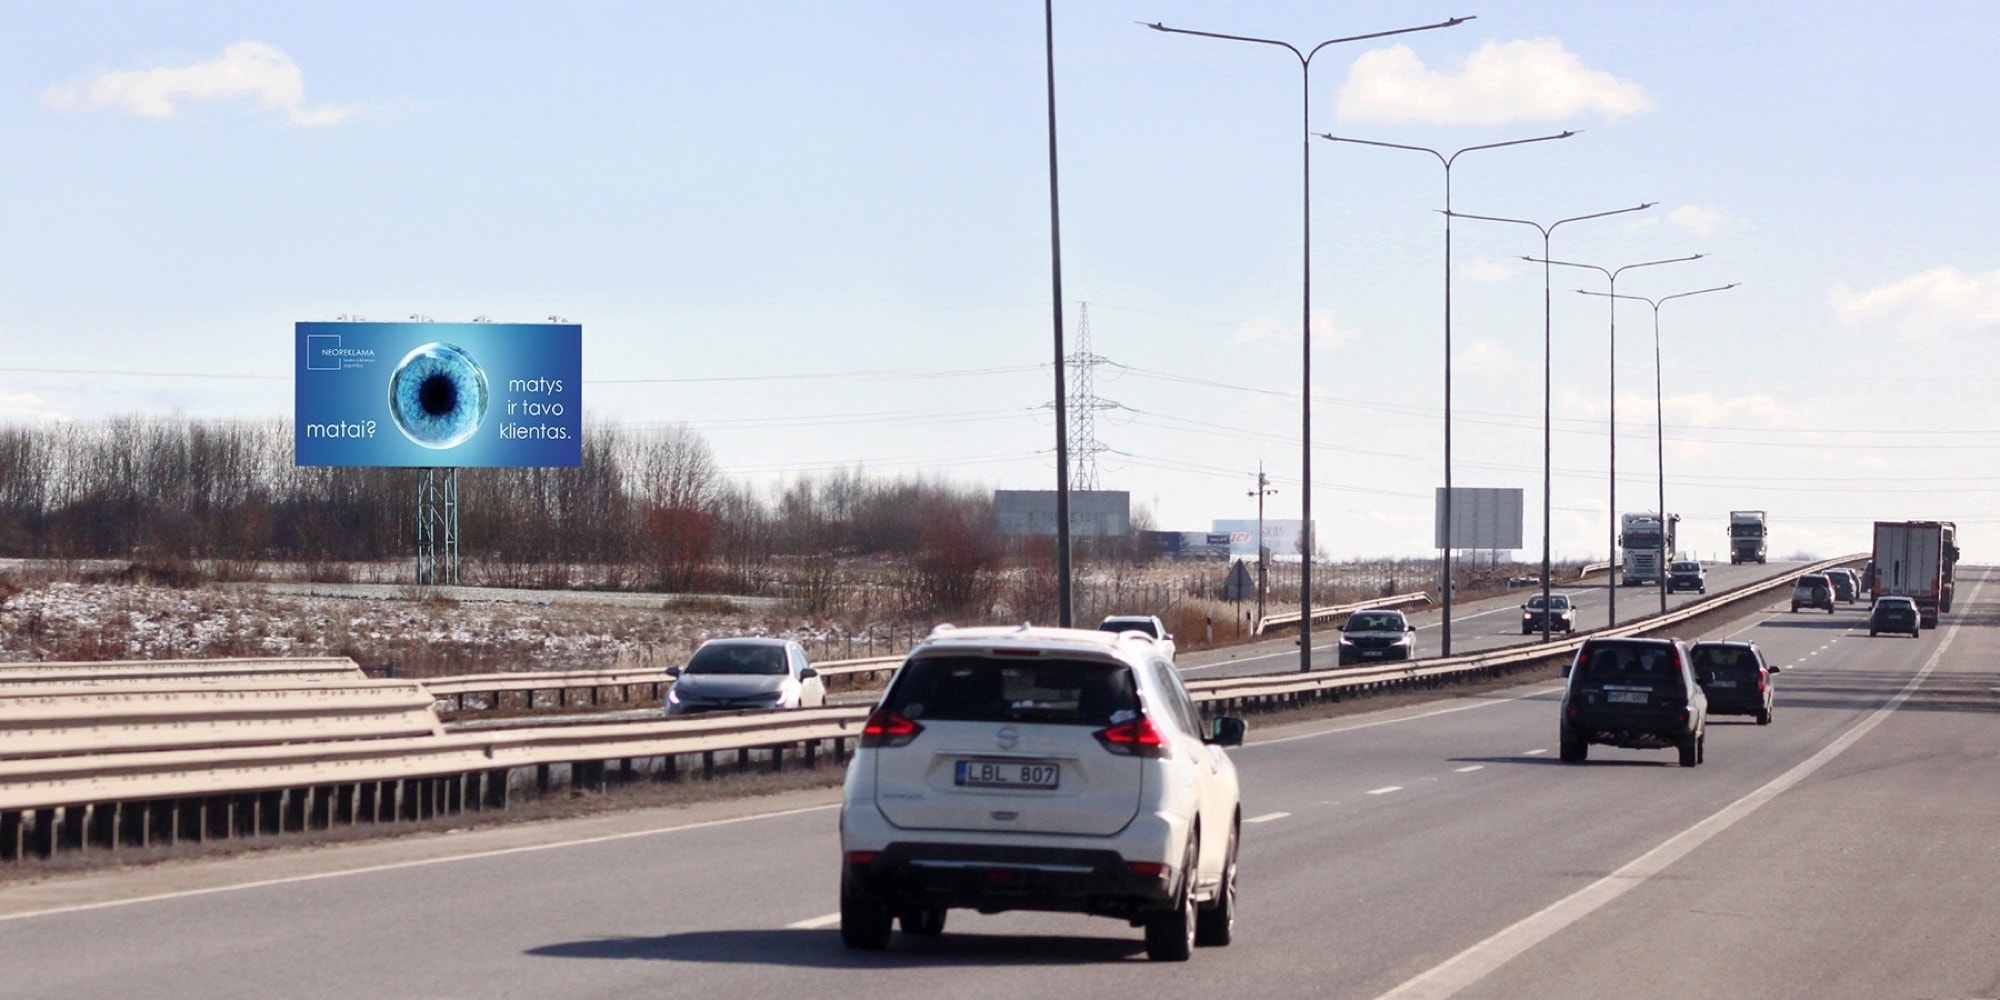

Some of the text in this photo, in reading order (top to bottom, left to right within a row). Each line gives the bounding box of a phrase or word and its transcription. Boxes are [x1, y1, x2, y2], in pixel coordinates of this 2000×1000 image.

[321, 349, 375, 357] NEOREKLAMA
[509, 377, 563, 396] matys
[507, 400, 564, 415] ir tavo
[307, 420, 377, 439] matai?
[499, 423, 572, 439] klientas.
[968, 765, 1054, 782] LBL 807
